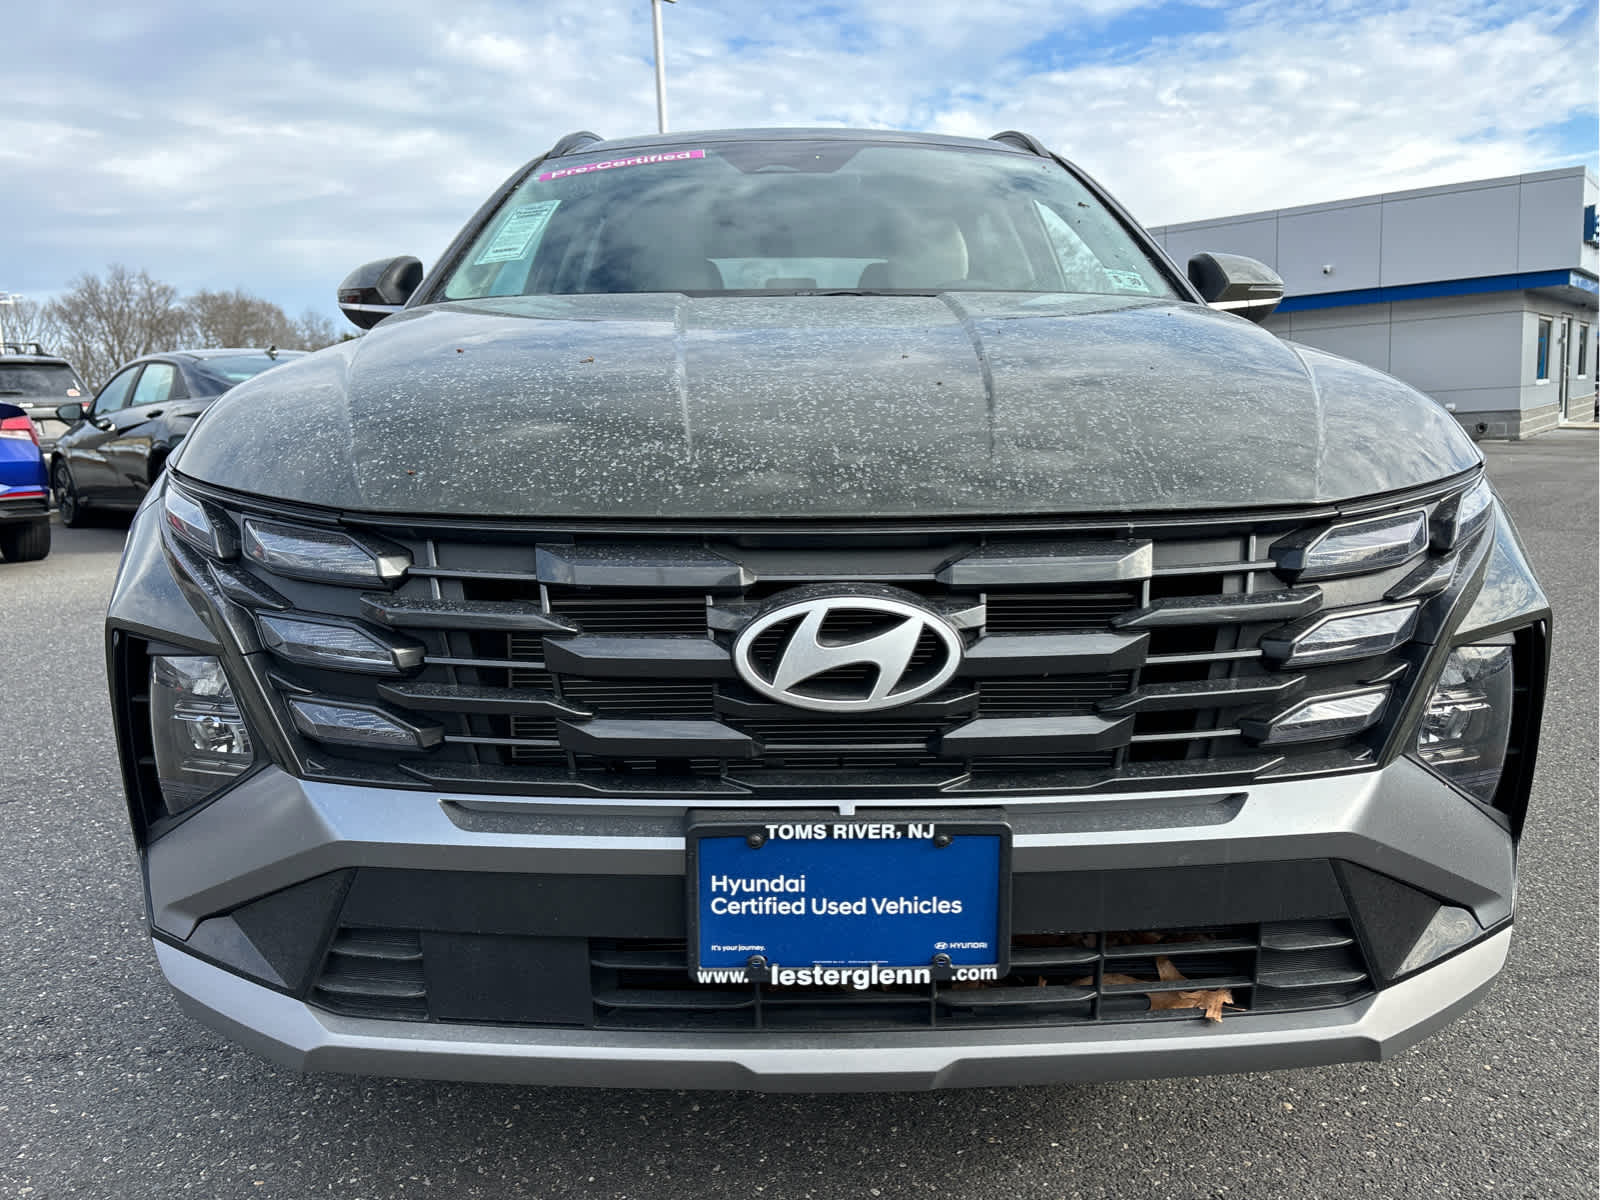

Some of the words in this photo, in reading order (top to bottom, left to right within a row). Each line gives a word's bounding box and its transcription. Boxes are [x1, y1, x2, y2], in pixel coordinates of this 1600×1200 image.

[551, 151, 691, 179] Pre-Certified
[766, 824, 828, 840] TOMS
[833, 824, 902, 840] RIVER,
[908, 823, 936, 839] NJ
[711, 874, 806, 896] Hyundai
[711, 896, 806, 915] Certified
[811, 897, 867, 915] Used
[871, 896, 963, 914] Vehicles
[697, 970, 749, 984] www.
[771, 964, 931, 990] lesterglenn
[951, 967, 998, 981] .com
